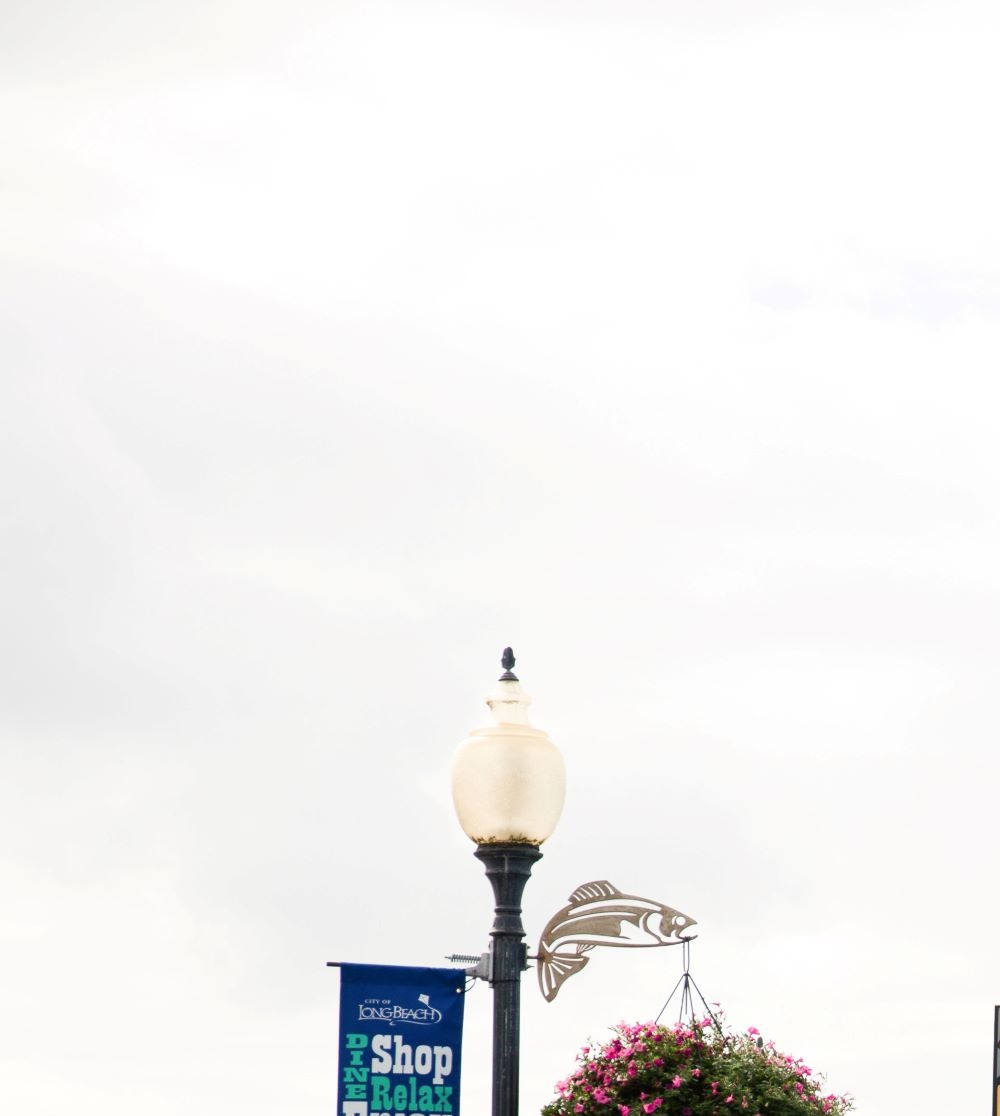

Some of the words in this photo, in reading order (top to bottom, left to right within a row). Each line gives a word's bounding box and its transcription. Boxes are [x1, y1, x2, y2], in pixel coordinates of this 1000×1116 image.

[343, 1033, 370, 1099] DINE
[371, 1034, 453, 1084] Shop
[371, 1076, 453, 1113] Relax
